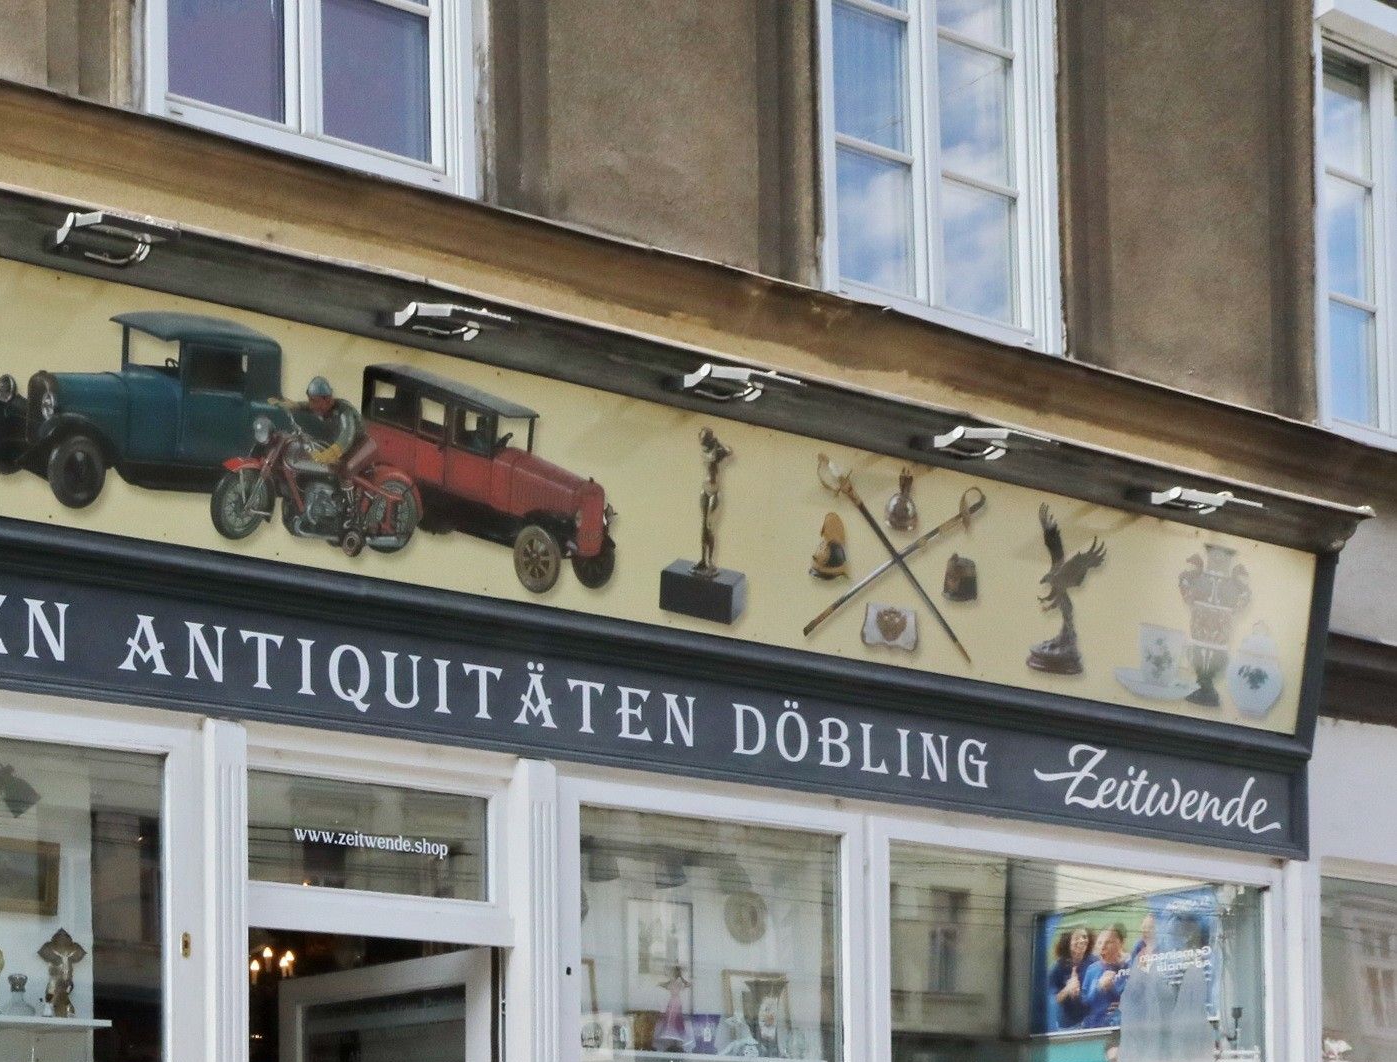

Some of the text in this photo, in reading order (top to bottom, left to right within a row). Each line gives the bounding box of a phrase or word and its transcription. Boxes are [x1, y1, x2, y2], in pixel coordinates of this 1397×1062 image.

[118, 613, 696, 748] ANTIQUITÄTEN
[732, 700, 989, 789] DÖBLING
[1034, 744, 1281, 834] Zeitwende
[294, 827, 448, 859] www.zeitwende.shop
